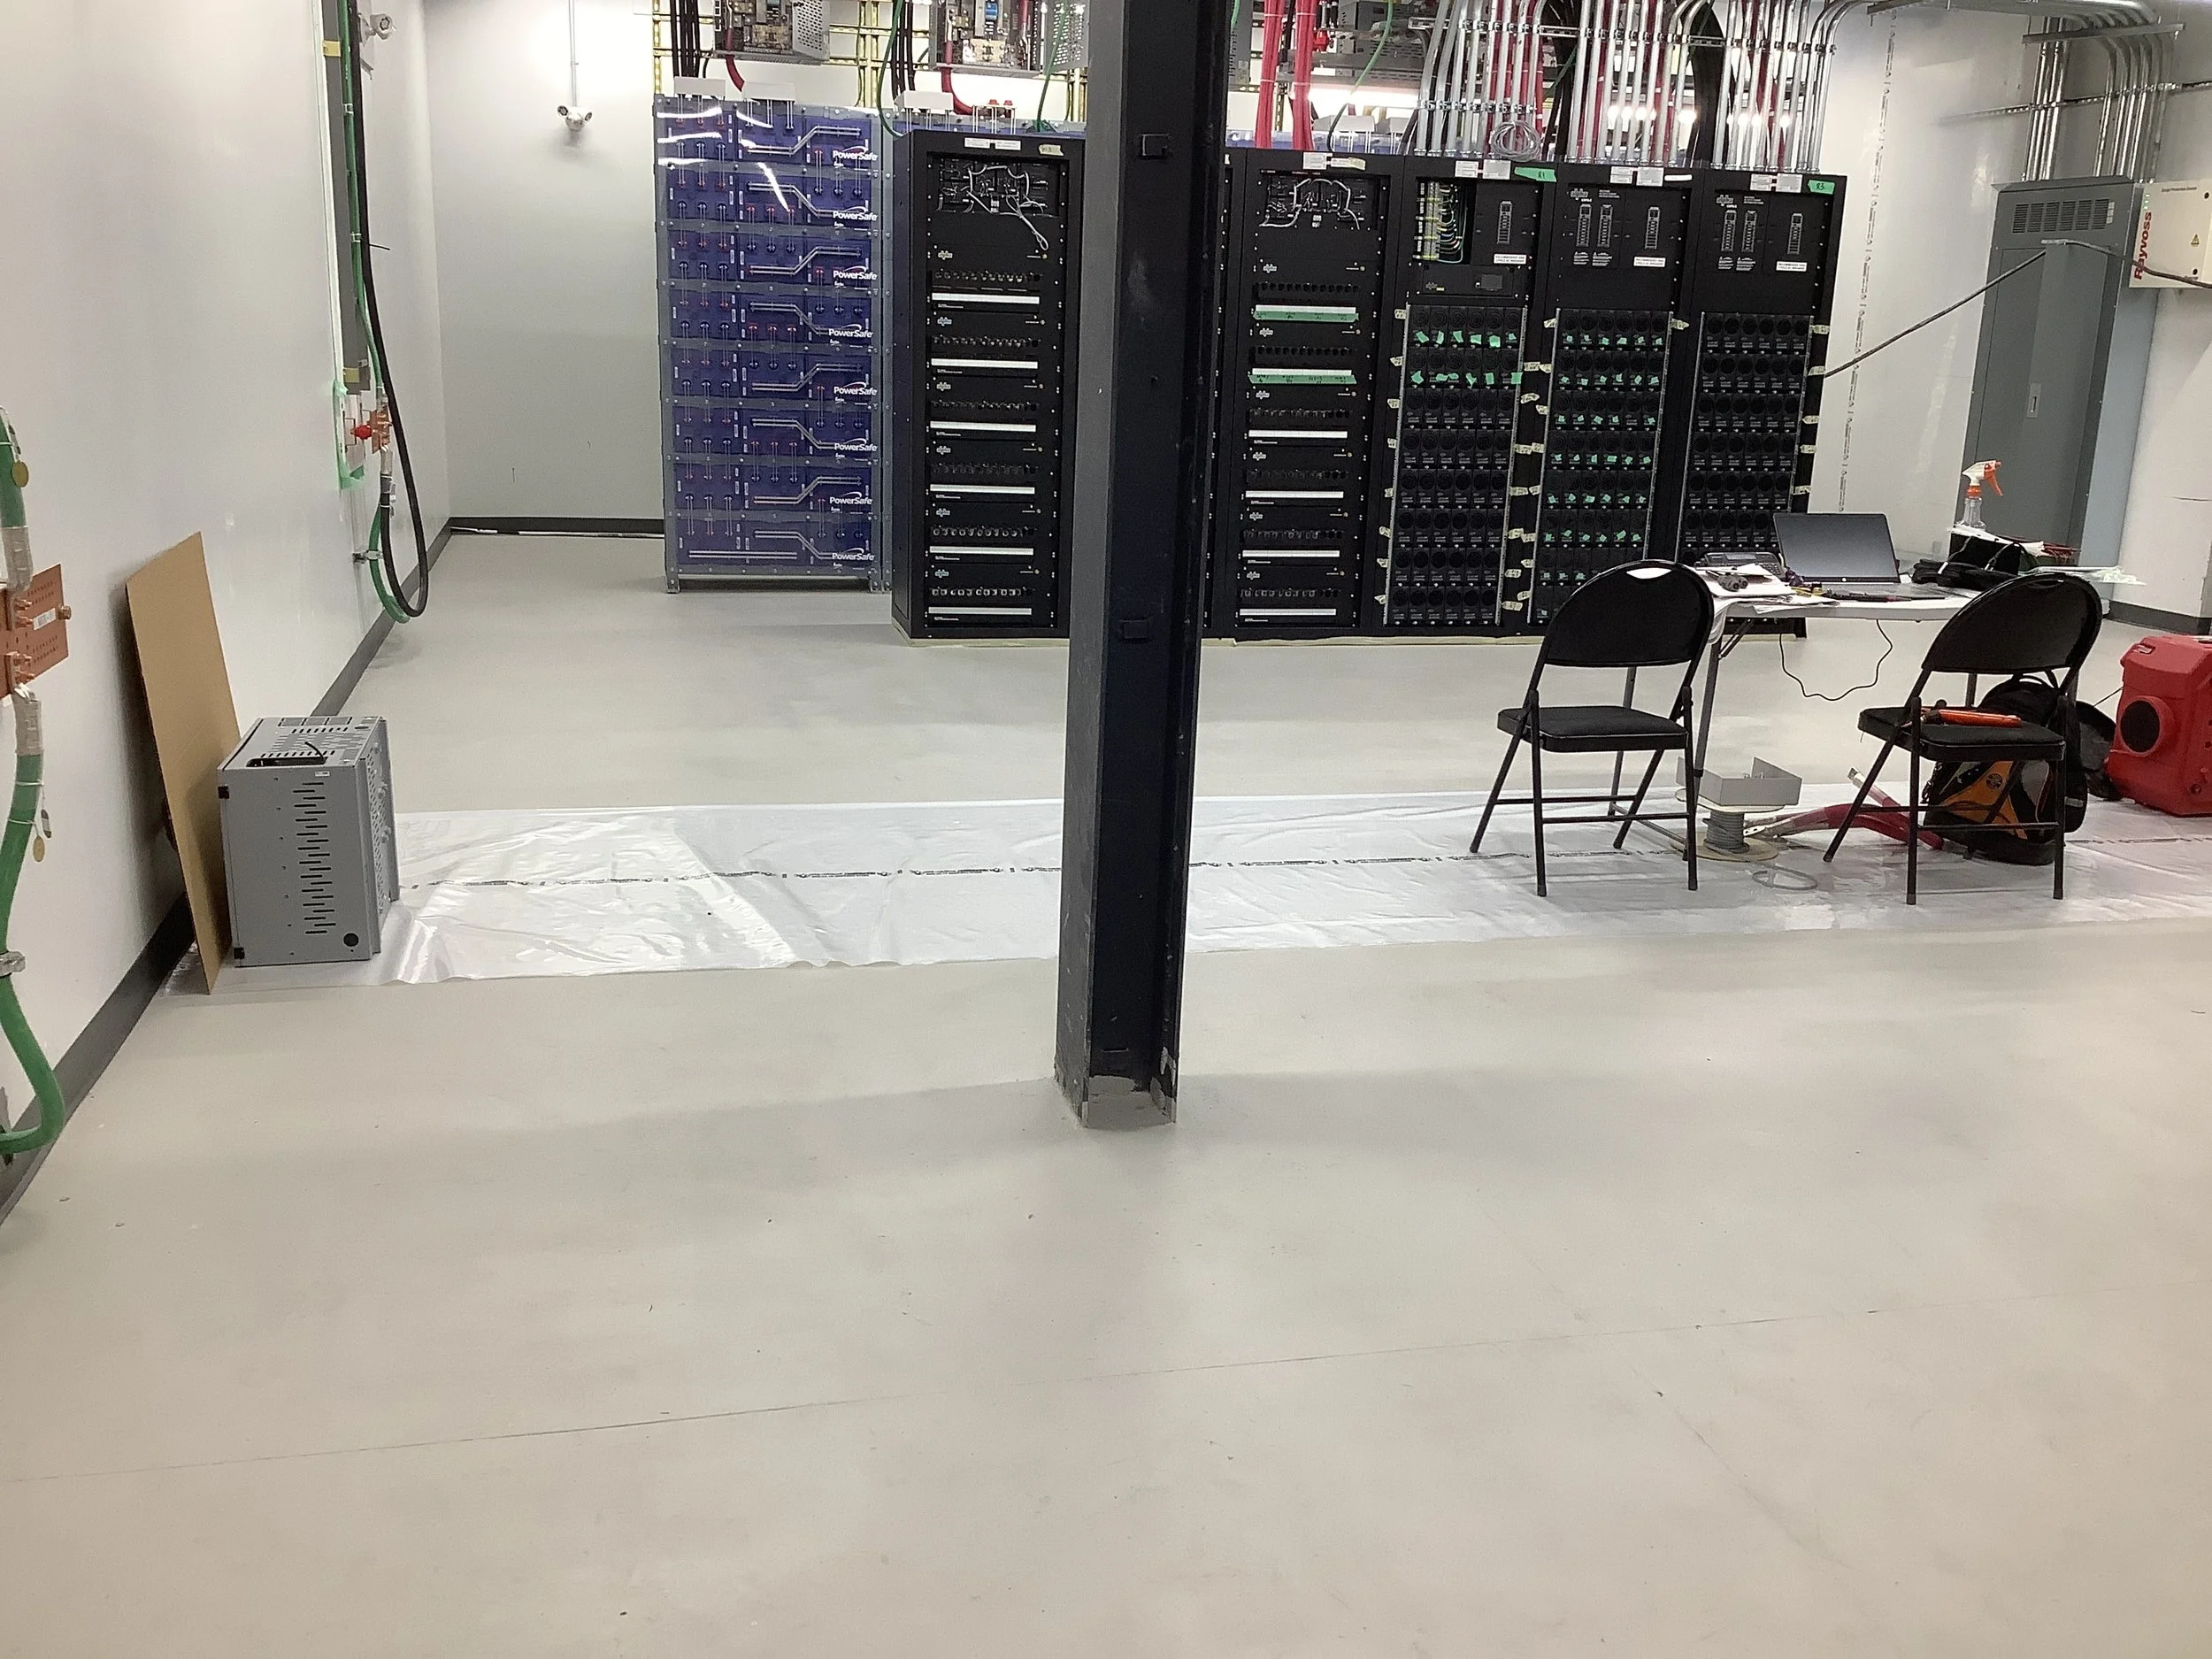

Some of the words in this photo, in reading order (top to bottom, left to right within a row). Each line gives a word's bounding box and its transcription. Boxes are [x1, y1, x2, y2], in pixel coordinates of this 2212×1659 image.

[833, 150, 878, 161] PowerSafe
[833, 211, 878, 221] PowerSafe
[833, 270, 878, 280] PowerSafe
[828, 328, 873, 338] PowerSafe
[833, 387, 878, 396] PowerSafe
[834, 443, 878, 452] PowerSafe
[829, 496, 872, 505] PowerSafe
